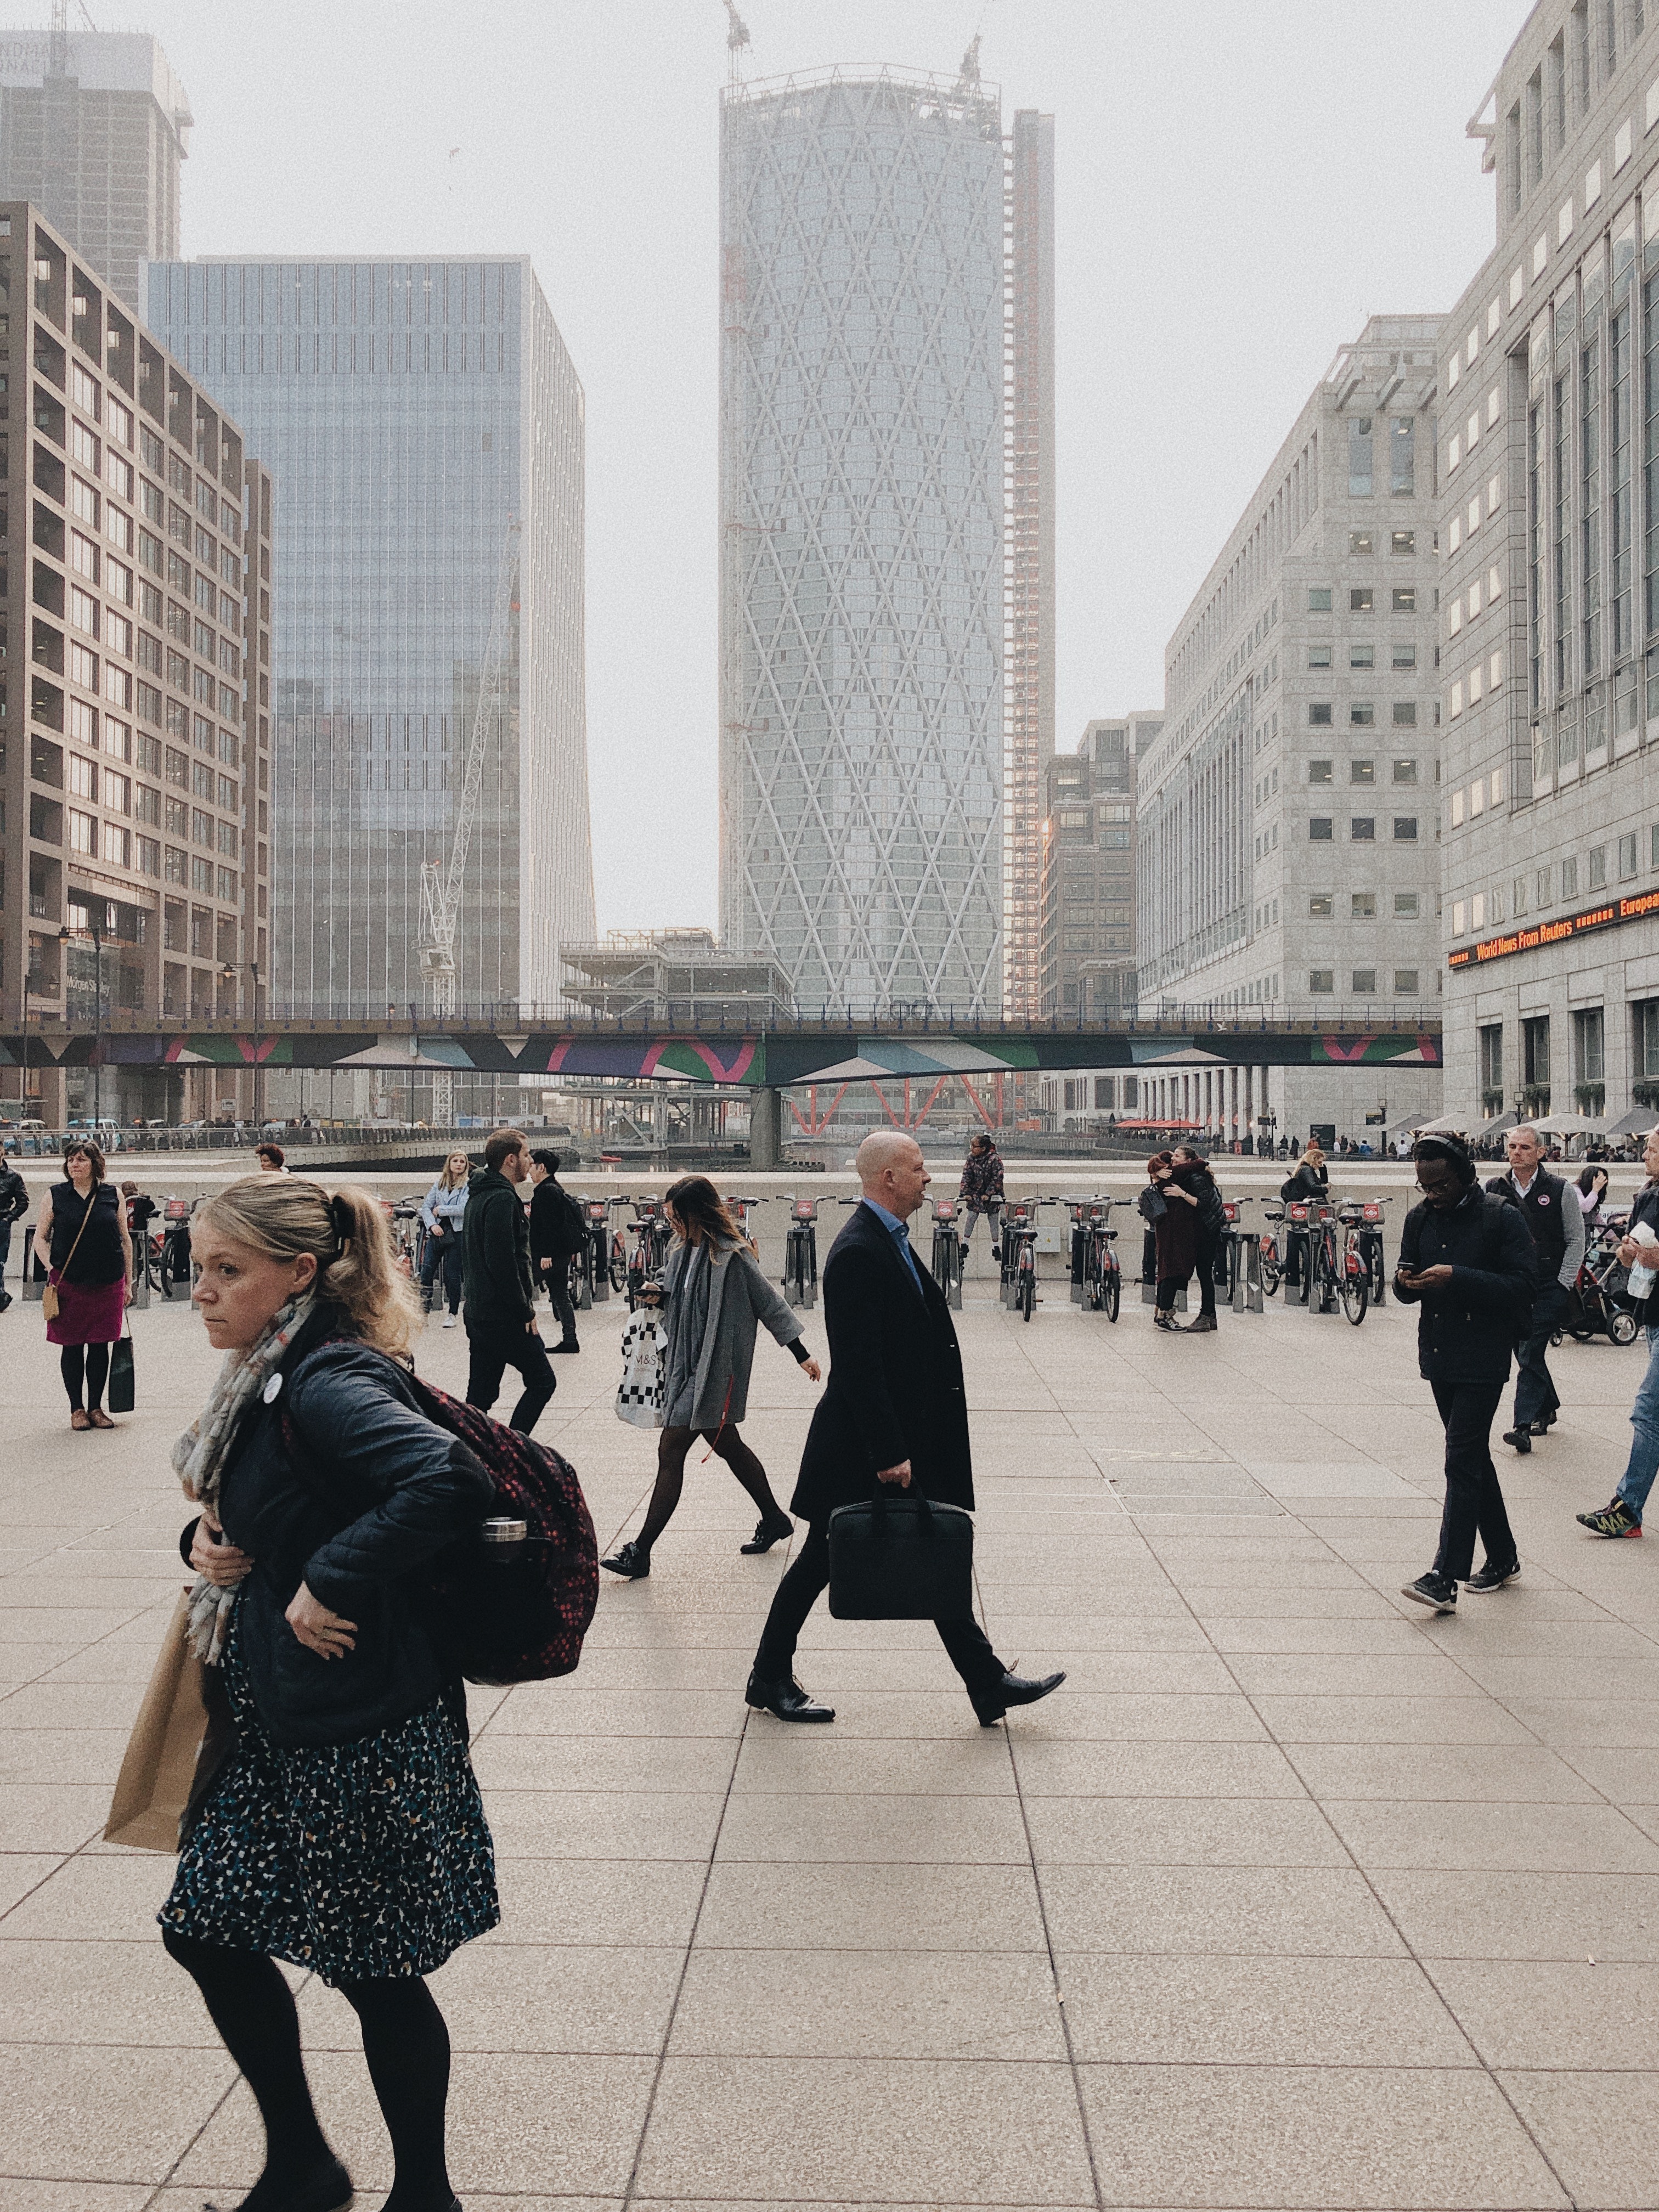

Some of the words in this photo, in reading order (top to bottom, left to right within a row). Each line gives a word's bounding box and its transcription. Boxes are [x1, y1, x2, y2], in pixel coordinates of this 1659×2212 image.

[1477, 939, 1497, 960] World
[1498, 937, 1517, 955] News
[1519, 931, 1539, 949] From
[1540, 921, 1573, 943] Reuters
[1620, 893, 1659, 917] Europea
[67, 976, 88, 992] Morgan
[89, 979, 110, 997] Stley
[635, 1354, 657, 1365] M&S
